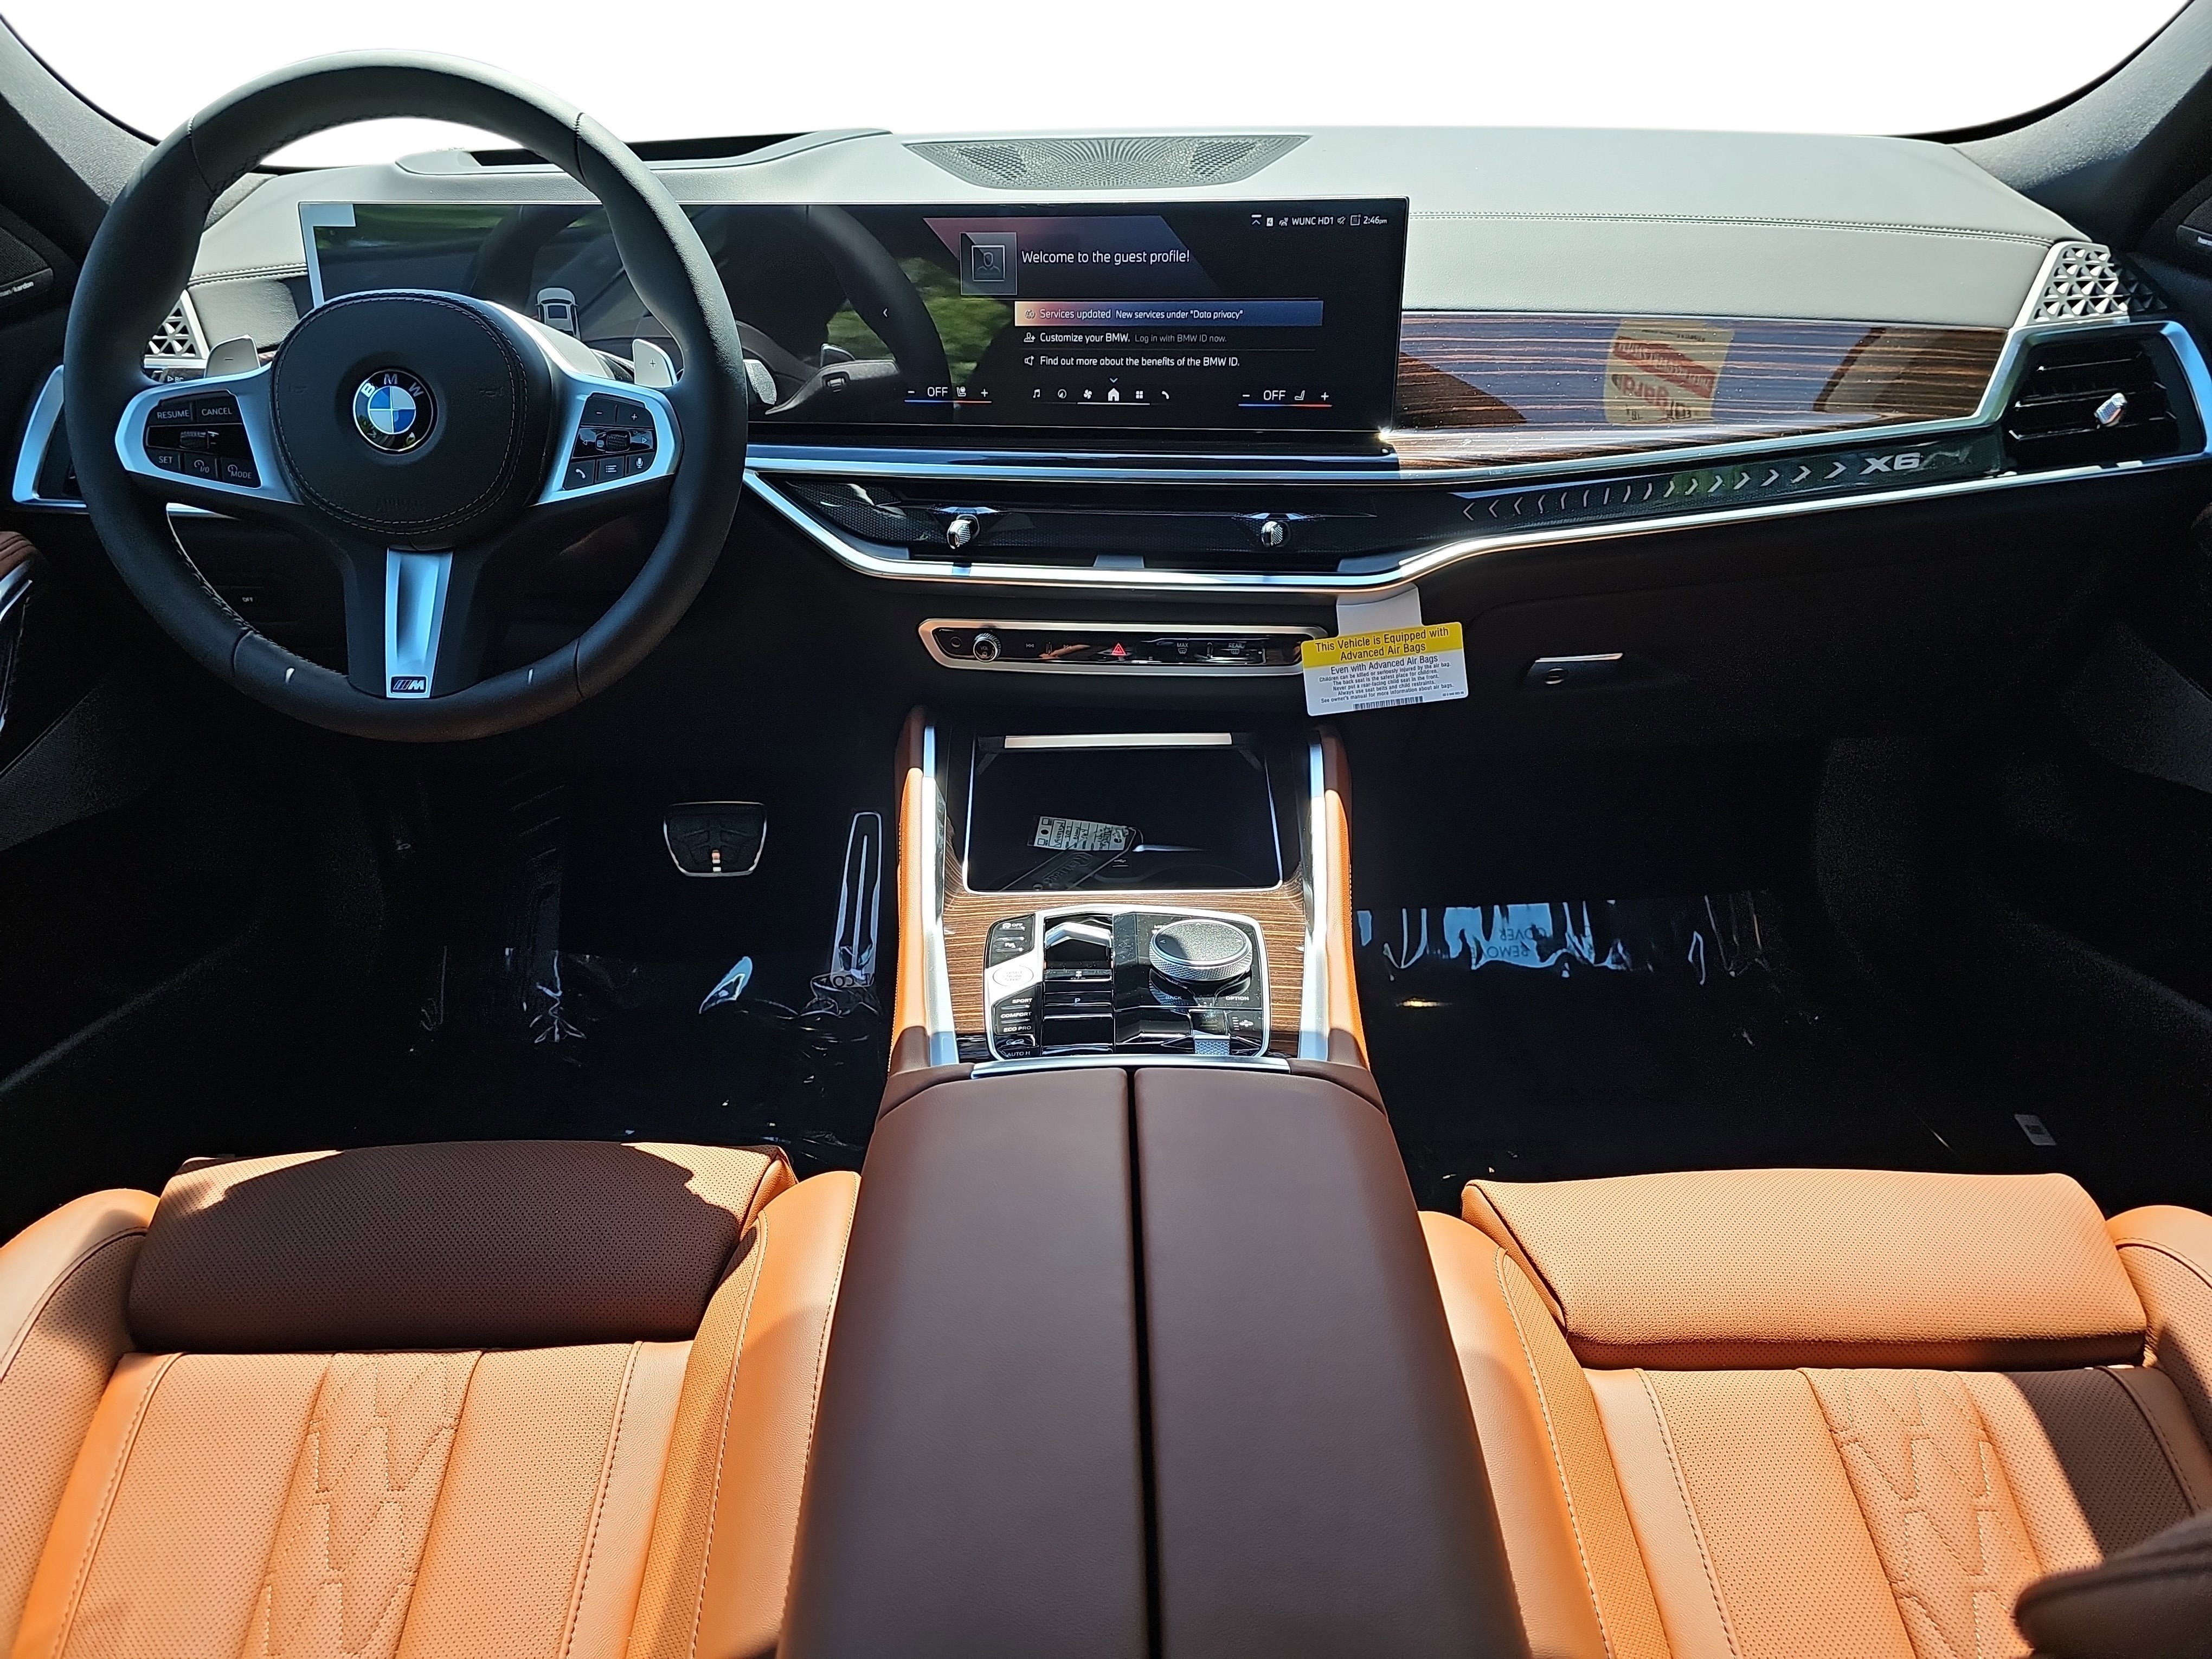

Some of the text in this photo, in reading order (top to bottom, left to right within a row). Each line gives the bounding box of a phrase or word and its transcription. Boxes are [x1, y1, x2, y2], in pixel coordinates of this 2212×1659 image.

[1292, 216, 1333, 225] WUNC HD1
[1363, 216, 1387, 224] 2:46pm
[1021, 249, 1190, 265] Welcome to the guest profile!
[1040, 308, 1111, 320] Services updated
[1116, 310, 1243, 319] New services under "Data privacy"
[1040, 332, 1130, 344] Customize your BMW.
[1135, 335, 1148, 343] Log
[1160, 334, 1175, 342] with
[1177, 334, 1197, 342] BMW
[1040, 356, 1058, 365] Find
[1060, 357, 1073, 365] out
[1099, 357, 1123, 365] about
[1126, 357, 1139, 365] the
[1141, 357, 1174, 366] benefits
[1177, 357, 1186, 366] of
[1187, 357, 1201, 366] the
[1203, 357, 1226, 366] BMW
[1229, 357, 1240, 366] ID.
[361, 373, 424, 397] BMW
[927, 387, 948, 397] OFF
[1264, 390, 1286, 401] OFF
[157, 409, 190, 419] RESUME
[201, 407, 233, 416] CANCEL
[1859, 452, 1920, 475] X6
[231, 471, 252, 479] MODE
[1315, 627, 1449, 652] This Vehicle is Equipped with
[1340, 643, 1425, 661] Advanced Air Bags
[1330, 655, 1438, 675] Even with Advanced Air Bags
[1390, 687, 1417, 695] information
